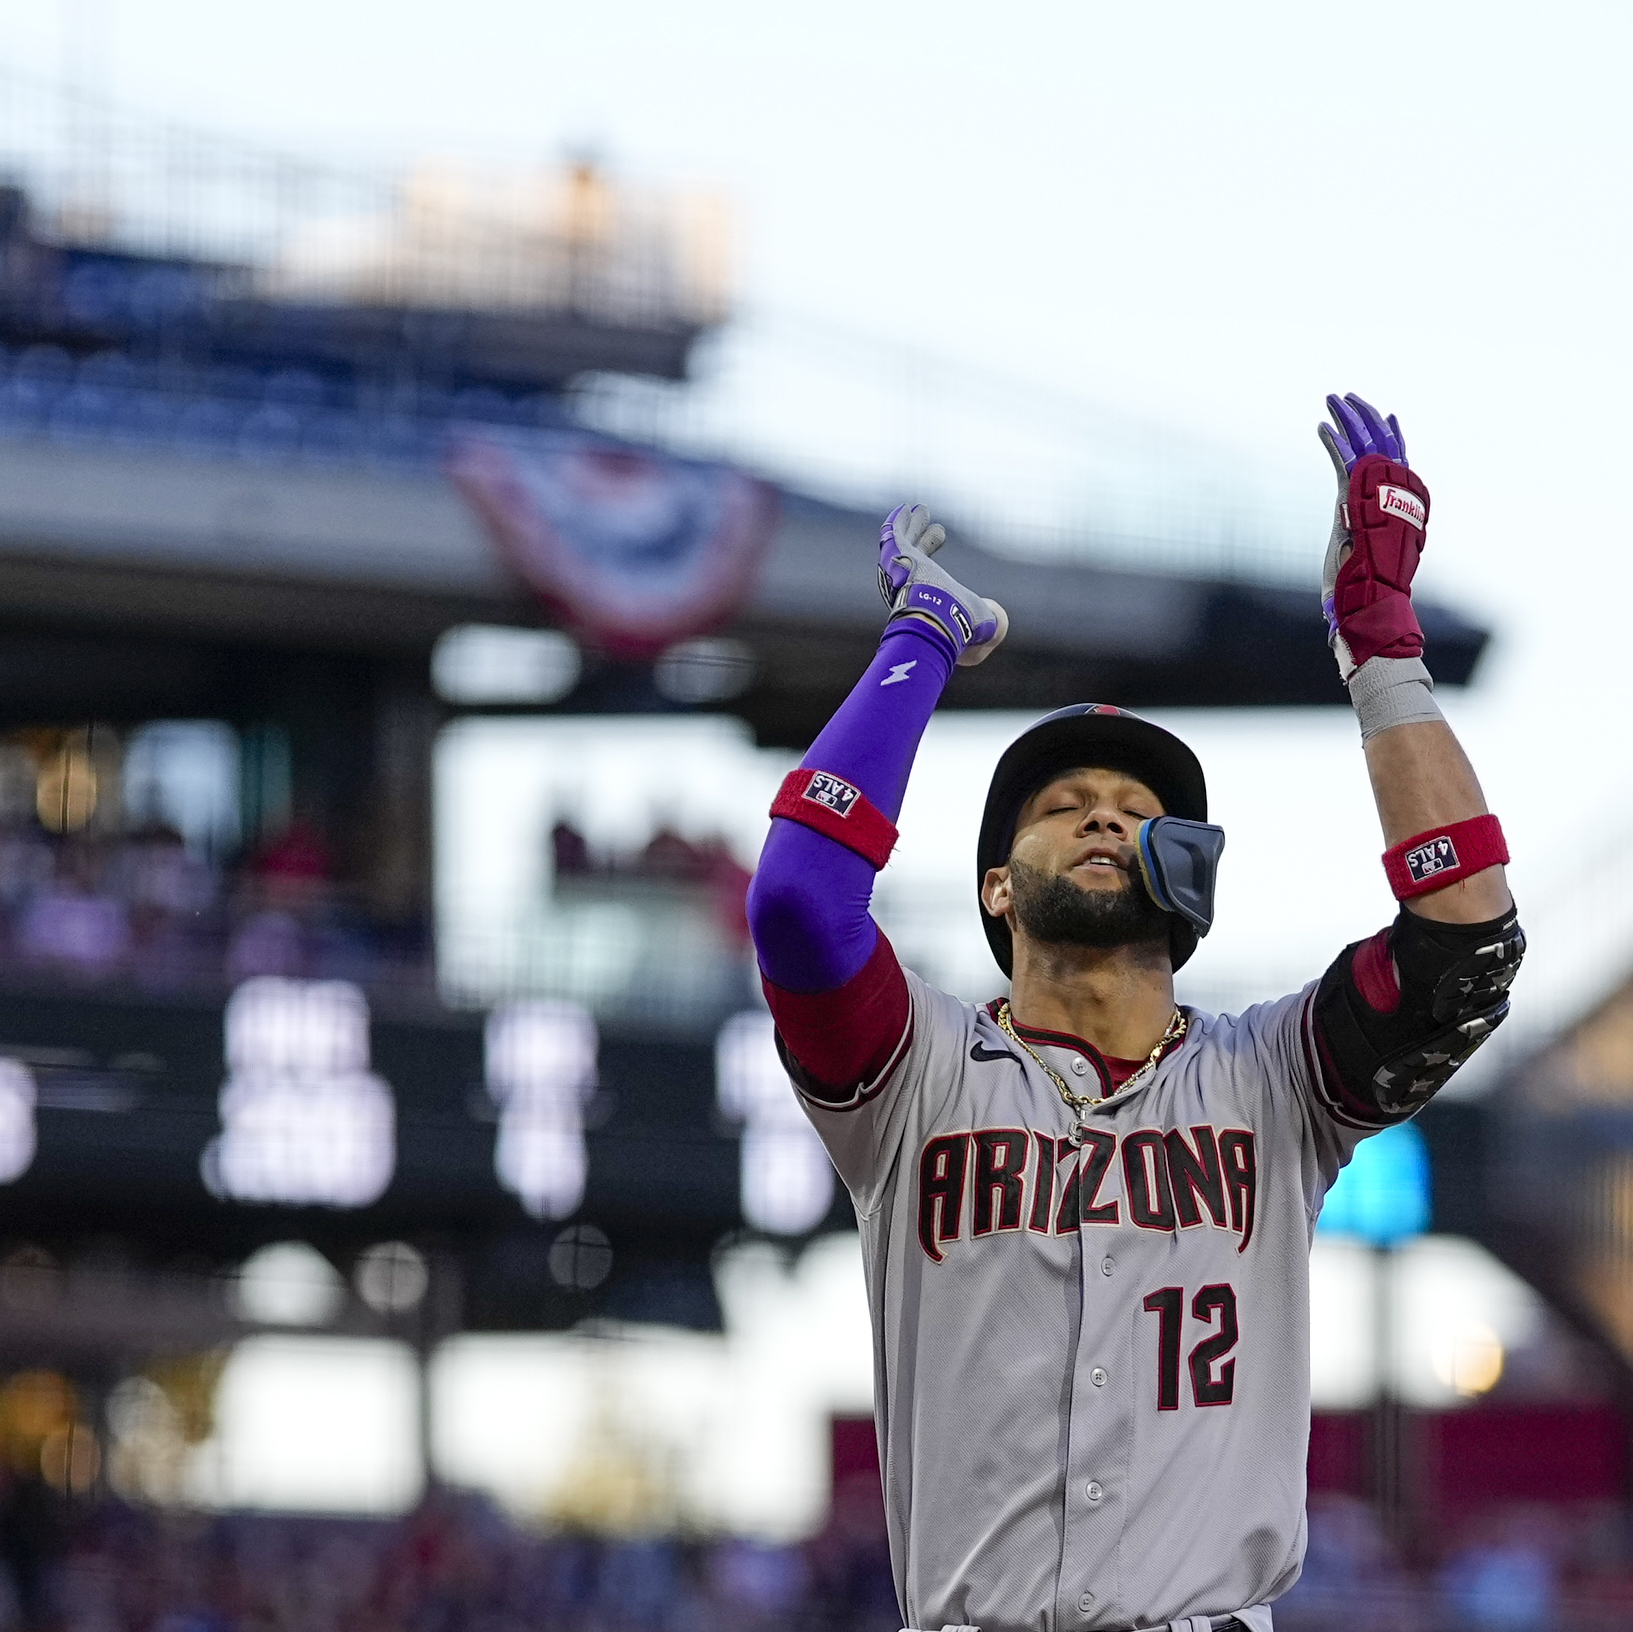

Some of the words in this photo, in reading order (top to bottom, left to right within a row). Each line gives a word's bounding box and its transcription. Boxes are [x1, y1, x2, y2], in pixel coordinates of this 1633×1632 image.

[918, 591, 943, 606] LG-12
[812, 774, 844, 796] ALS
[841, 788, 854, 802] 4
[1407, 843, 1435, 868] ALS
[1437, 841, 1449, 857] 4
[918, 1125, 1256, 1264] ARIZONA
[1143, 1282, 1239, 1412] 12
